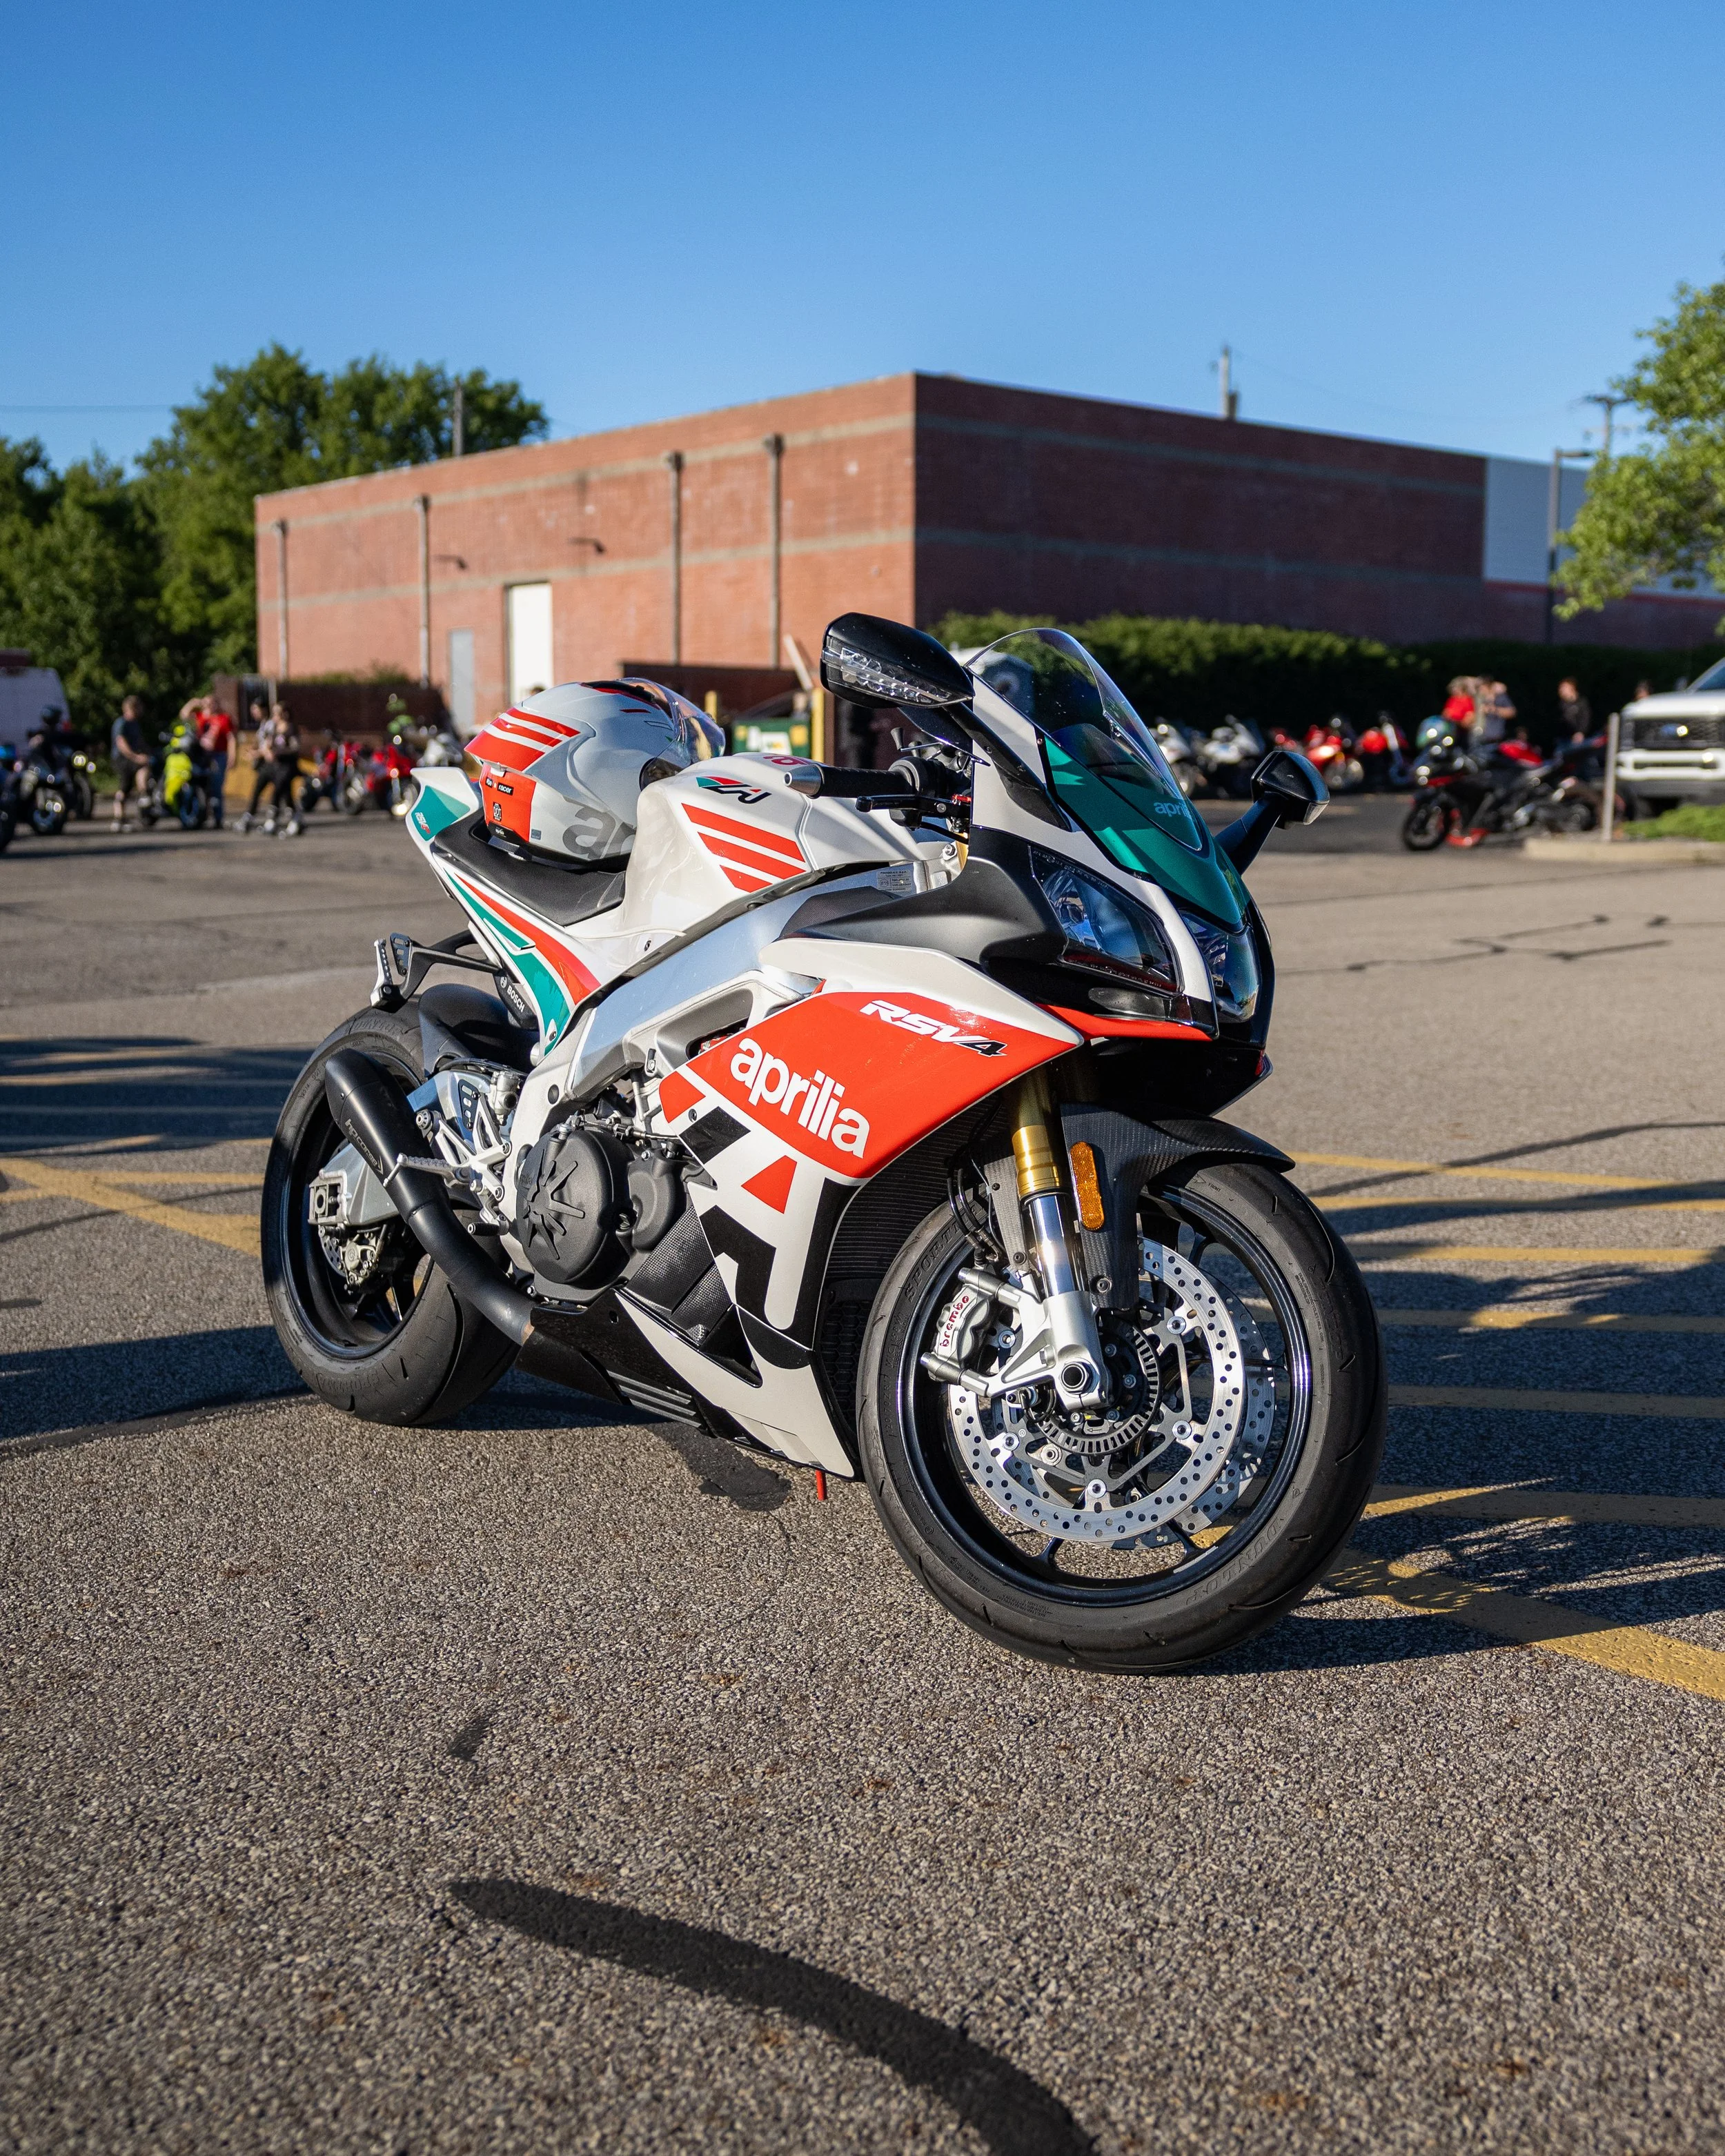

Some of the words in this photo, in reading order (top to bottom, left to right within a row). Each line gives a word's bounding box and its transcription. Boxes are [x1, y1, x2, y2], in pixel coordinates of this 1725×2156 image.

[498, 784, 512, 793] racer
[506, 985, 525, 1013] BOSCH
[860, 1000, 1008, 1057] RSV4
[730, 1038, 870, 1159] aprilia
[940, 1296, 969, 1347] brembo
[1185, 1517, 1281, 1605] DUNLOP
